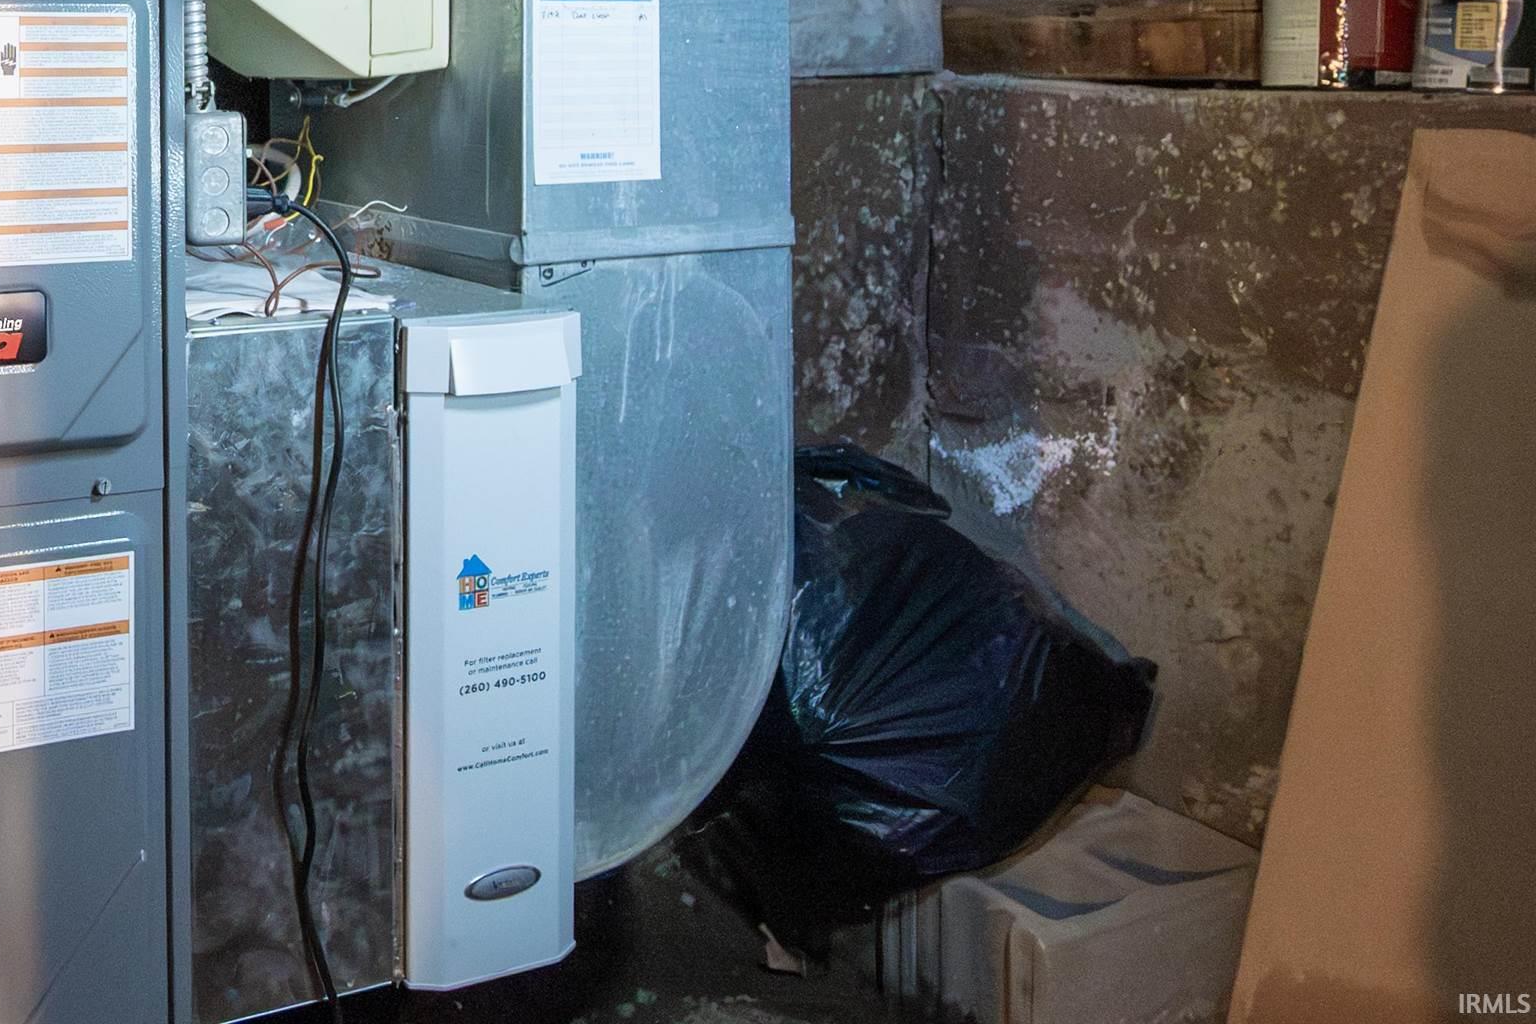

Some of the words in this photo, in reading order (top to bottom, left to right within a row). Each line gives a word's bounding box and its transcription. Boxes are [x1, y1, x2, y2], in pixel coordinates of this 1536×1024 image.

[491, 572, 520, 587] Comfort
[522, 570, 550, 582] Experts
[464, 659, 477, 667] For
[478, 656, 496, 665] filter
[497, 648, 542, 661] replacement
[477, 661, 524, 674] maintenance
[525, 657, 538, 666] call
[459, 682, 491, 697] (260)
[494, 671, 546, 689] 490-5100
[491, 741, 506, 751] visit
